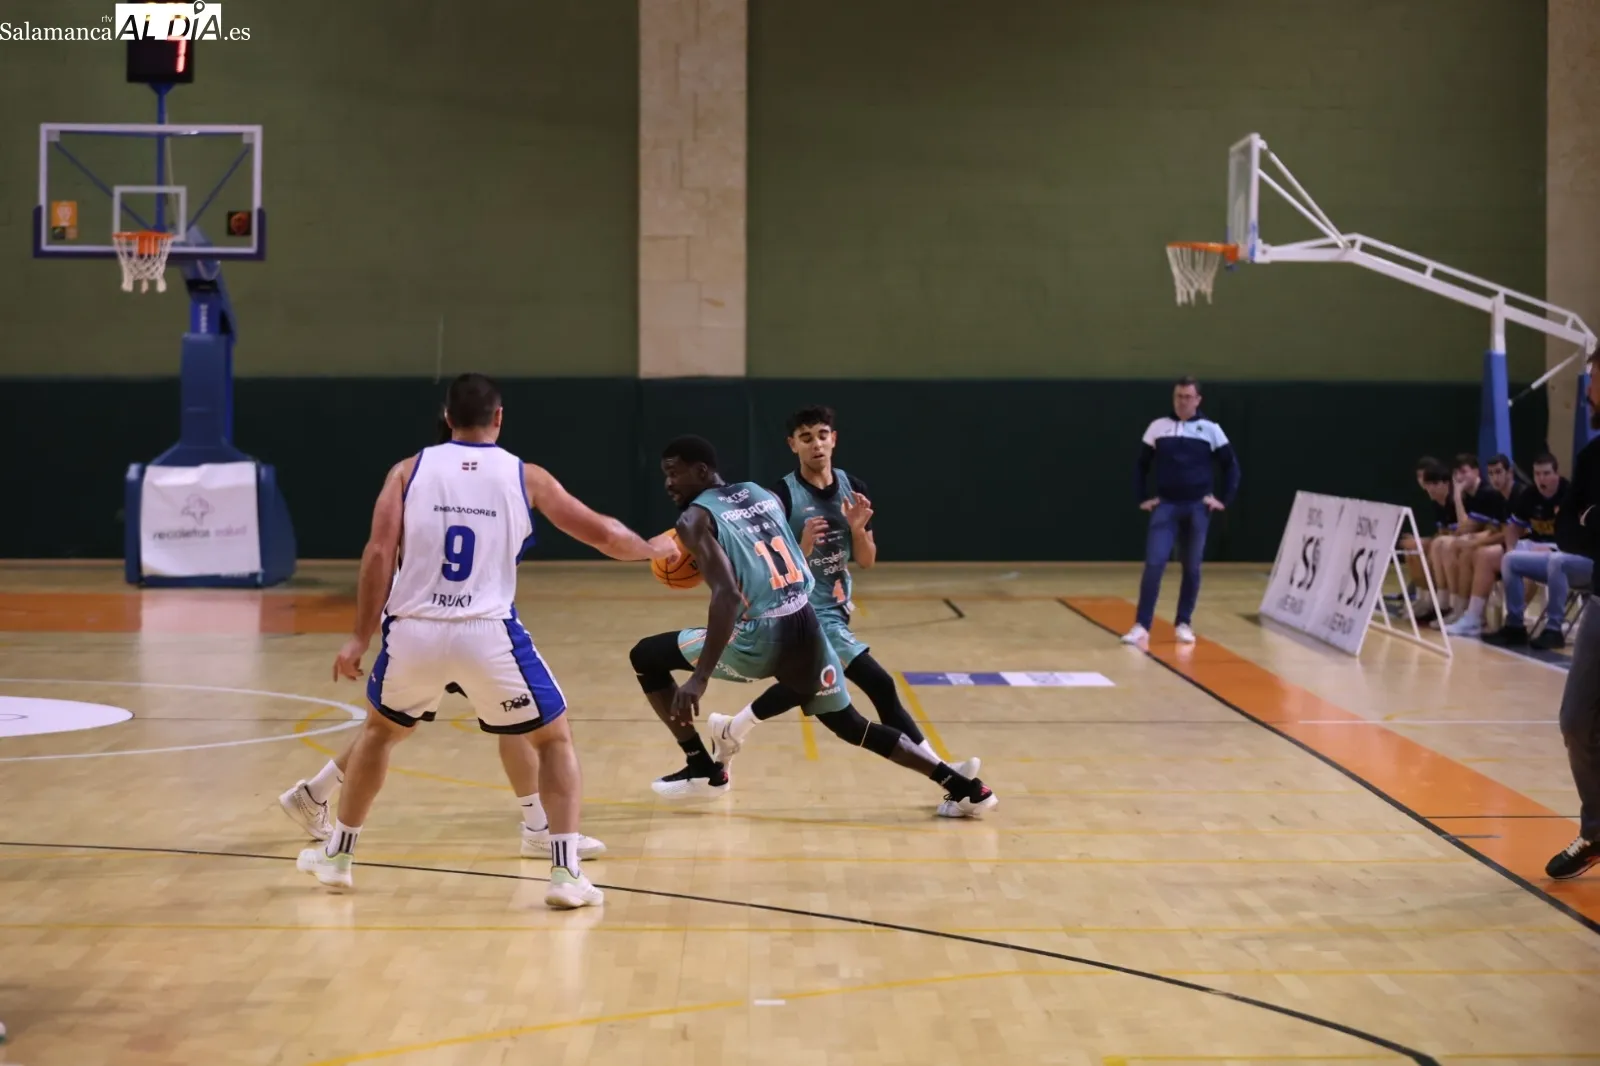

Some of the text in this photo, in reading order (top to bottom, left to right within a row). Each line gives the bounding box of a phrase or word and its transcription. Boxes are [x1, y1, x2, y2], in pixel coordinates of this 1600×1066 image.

[433, 505, 497, 518] EMBAJADORES
[442, 525, 476, 582] 9
[755, 536, 804, 590] 11
[500, 693, 531, 712] 1988
